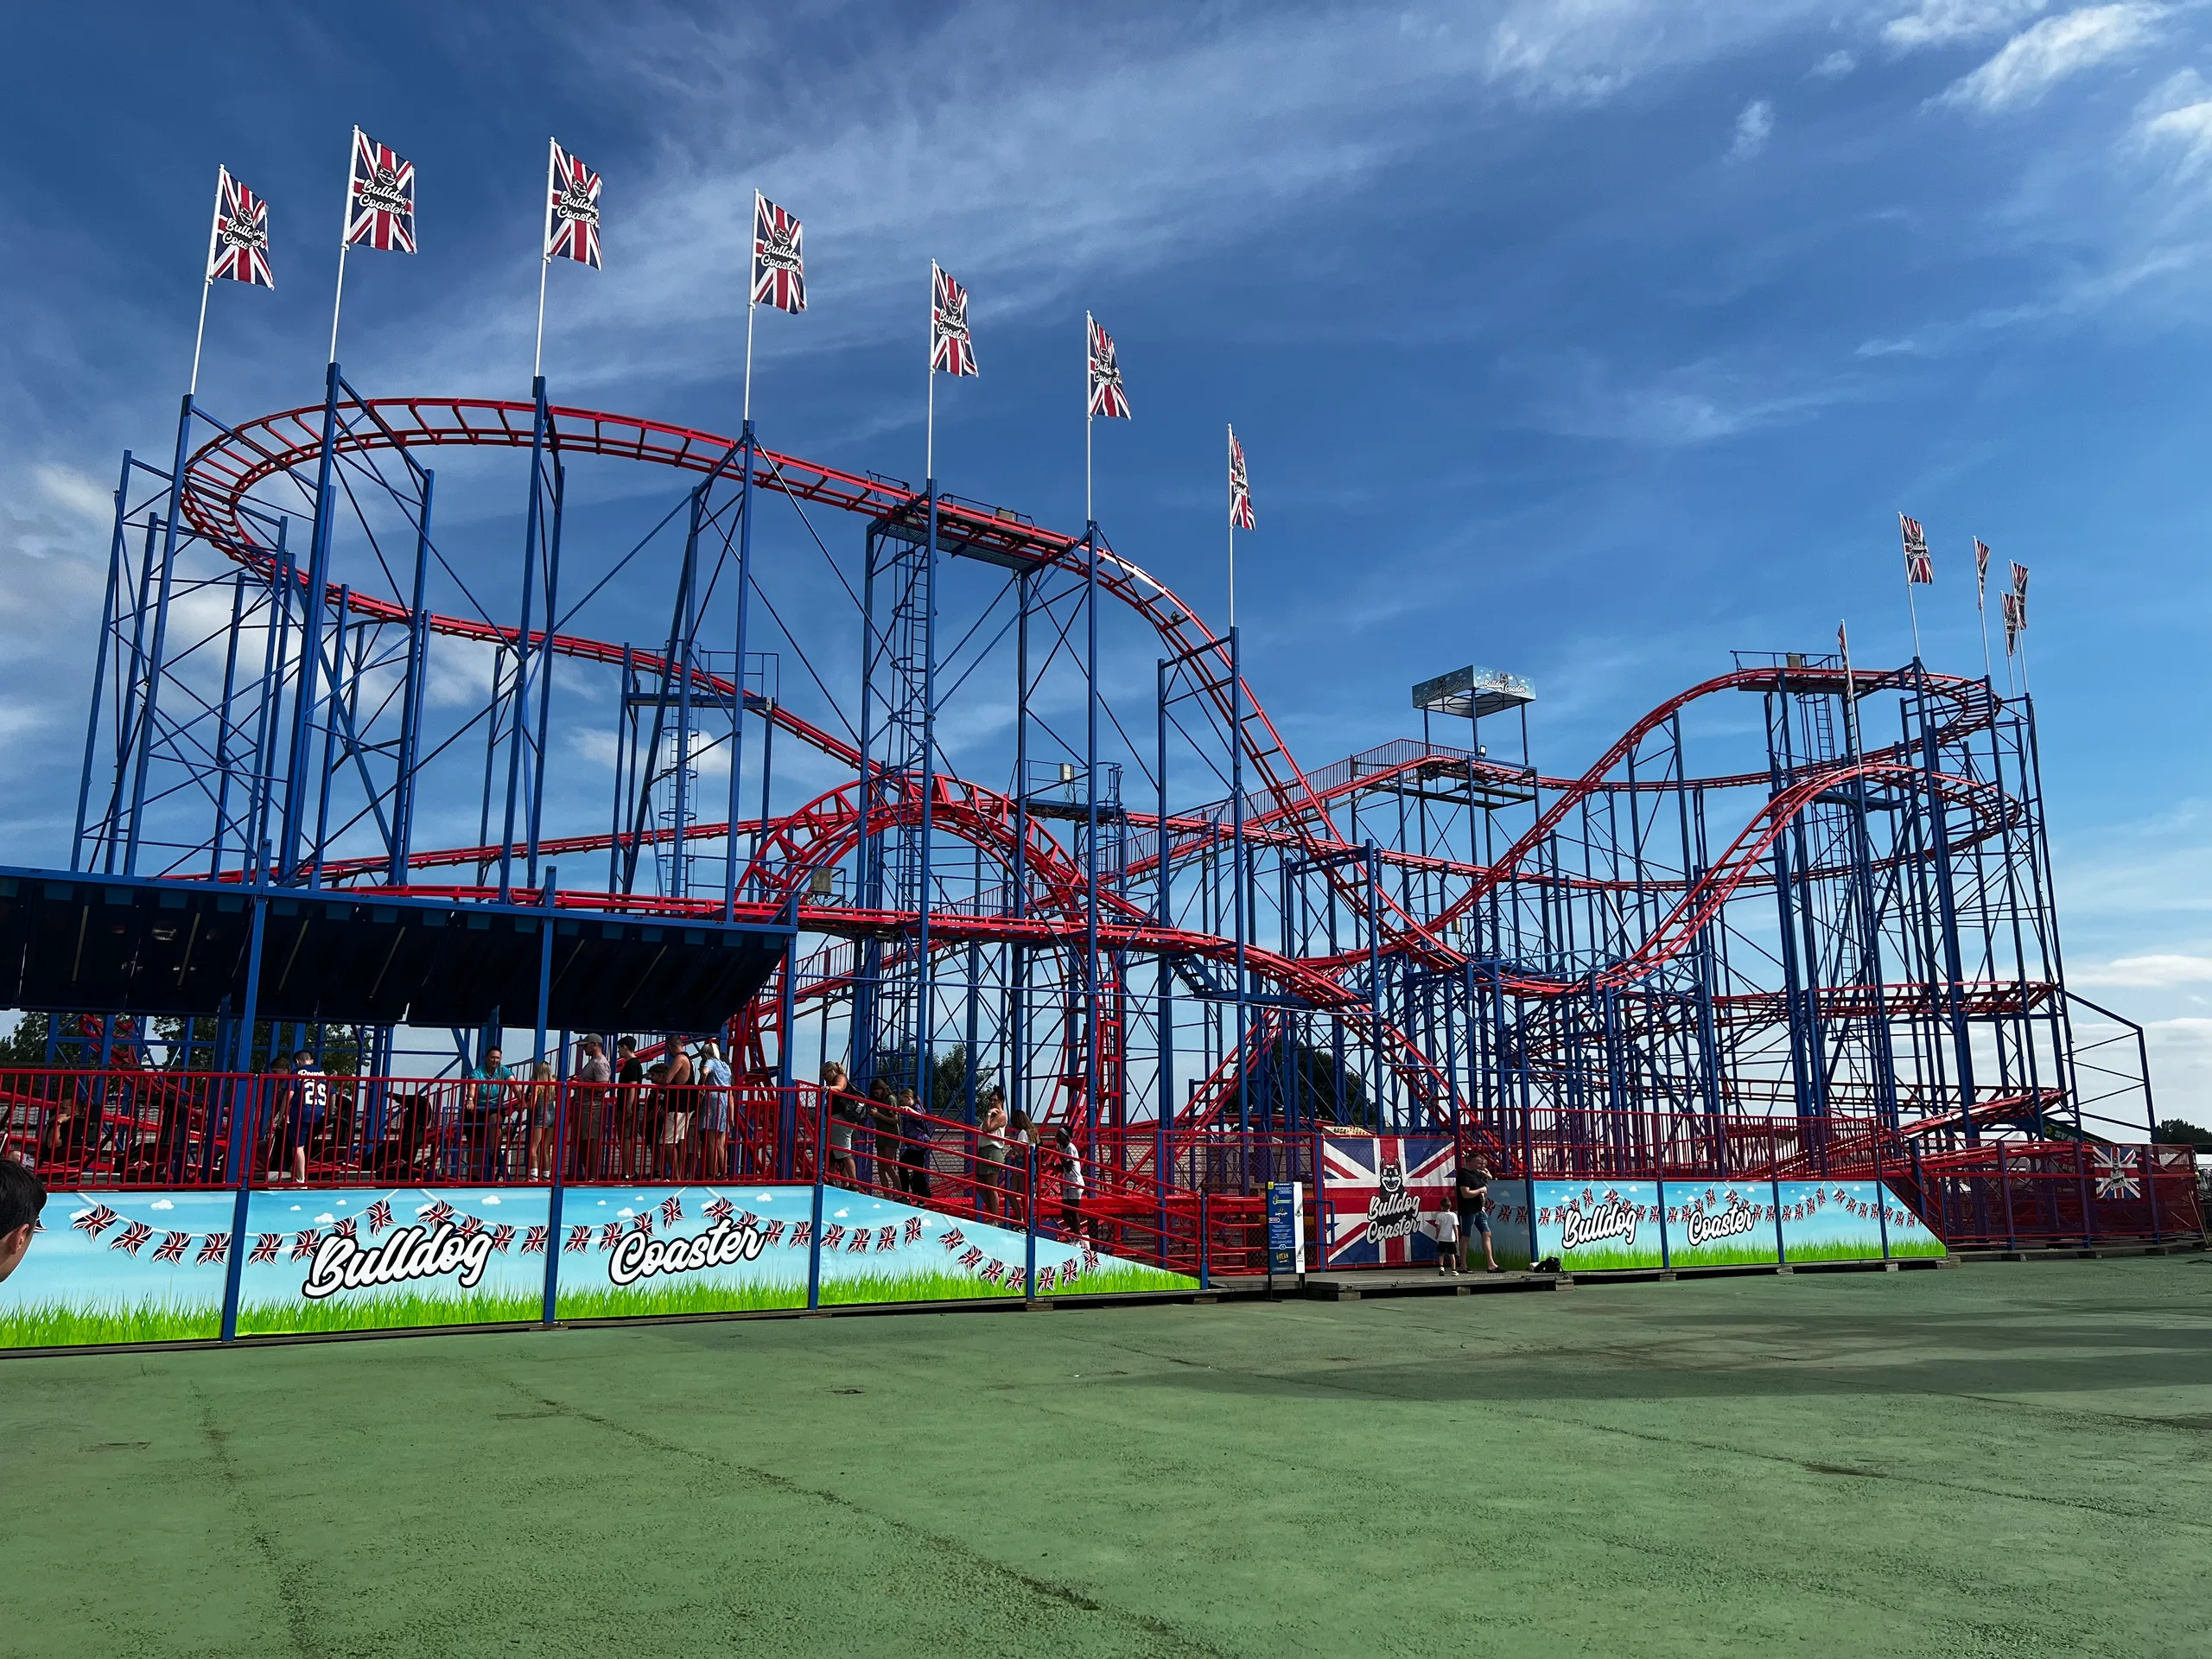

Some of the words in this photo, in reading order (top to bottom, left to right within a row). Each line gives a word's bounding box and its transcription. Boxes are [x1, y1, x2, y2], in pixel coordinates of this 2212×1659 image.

[359, 194, 407, 215] Coaster
[362, 179, 408, 207] Bulldog
[560, 190, 600, 219] Bulldog
[557, 205, 601, 228] Coaster
[222, 232, 266, 250] Coaser
[763, 239, 801, 266] Bulldog
[760, 254, 801, 275] Coaster
[937, 321, 967, 340] Coaste
[938, 308, 967, 329] Bulld
[1368, 1192, 1421, 1220] Bulldog
[1366, 1214, 1420, 1244] Coaster
[1562, 1201, 1638, 1249] Bulldog
[1688, 1200, 1755, 1246] Coaster
[302, 1222, 494, 1299] Bulldog
[608, 1216, 767, 1286] Coaster
